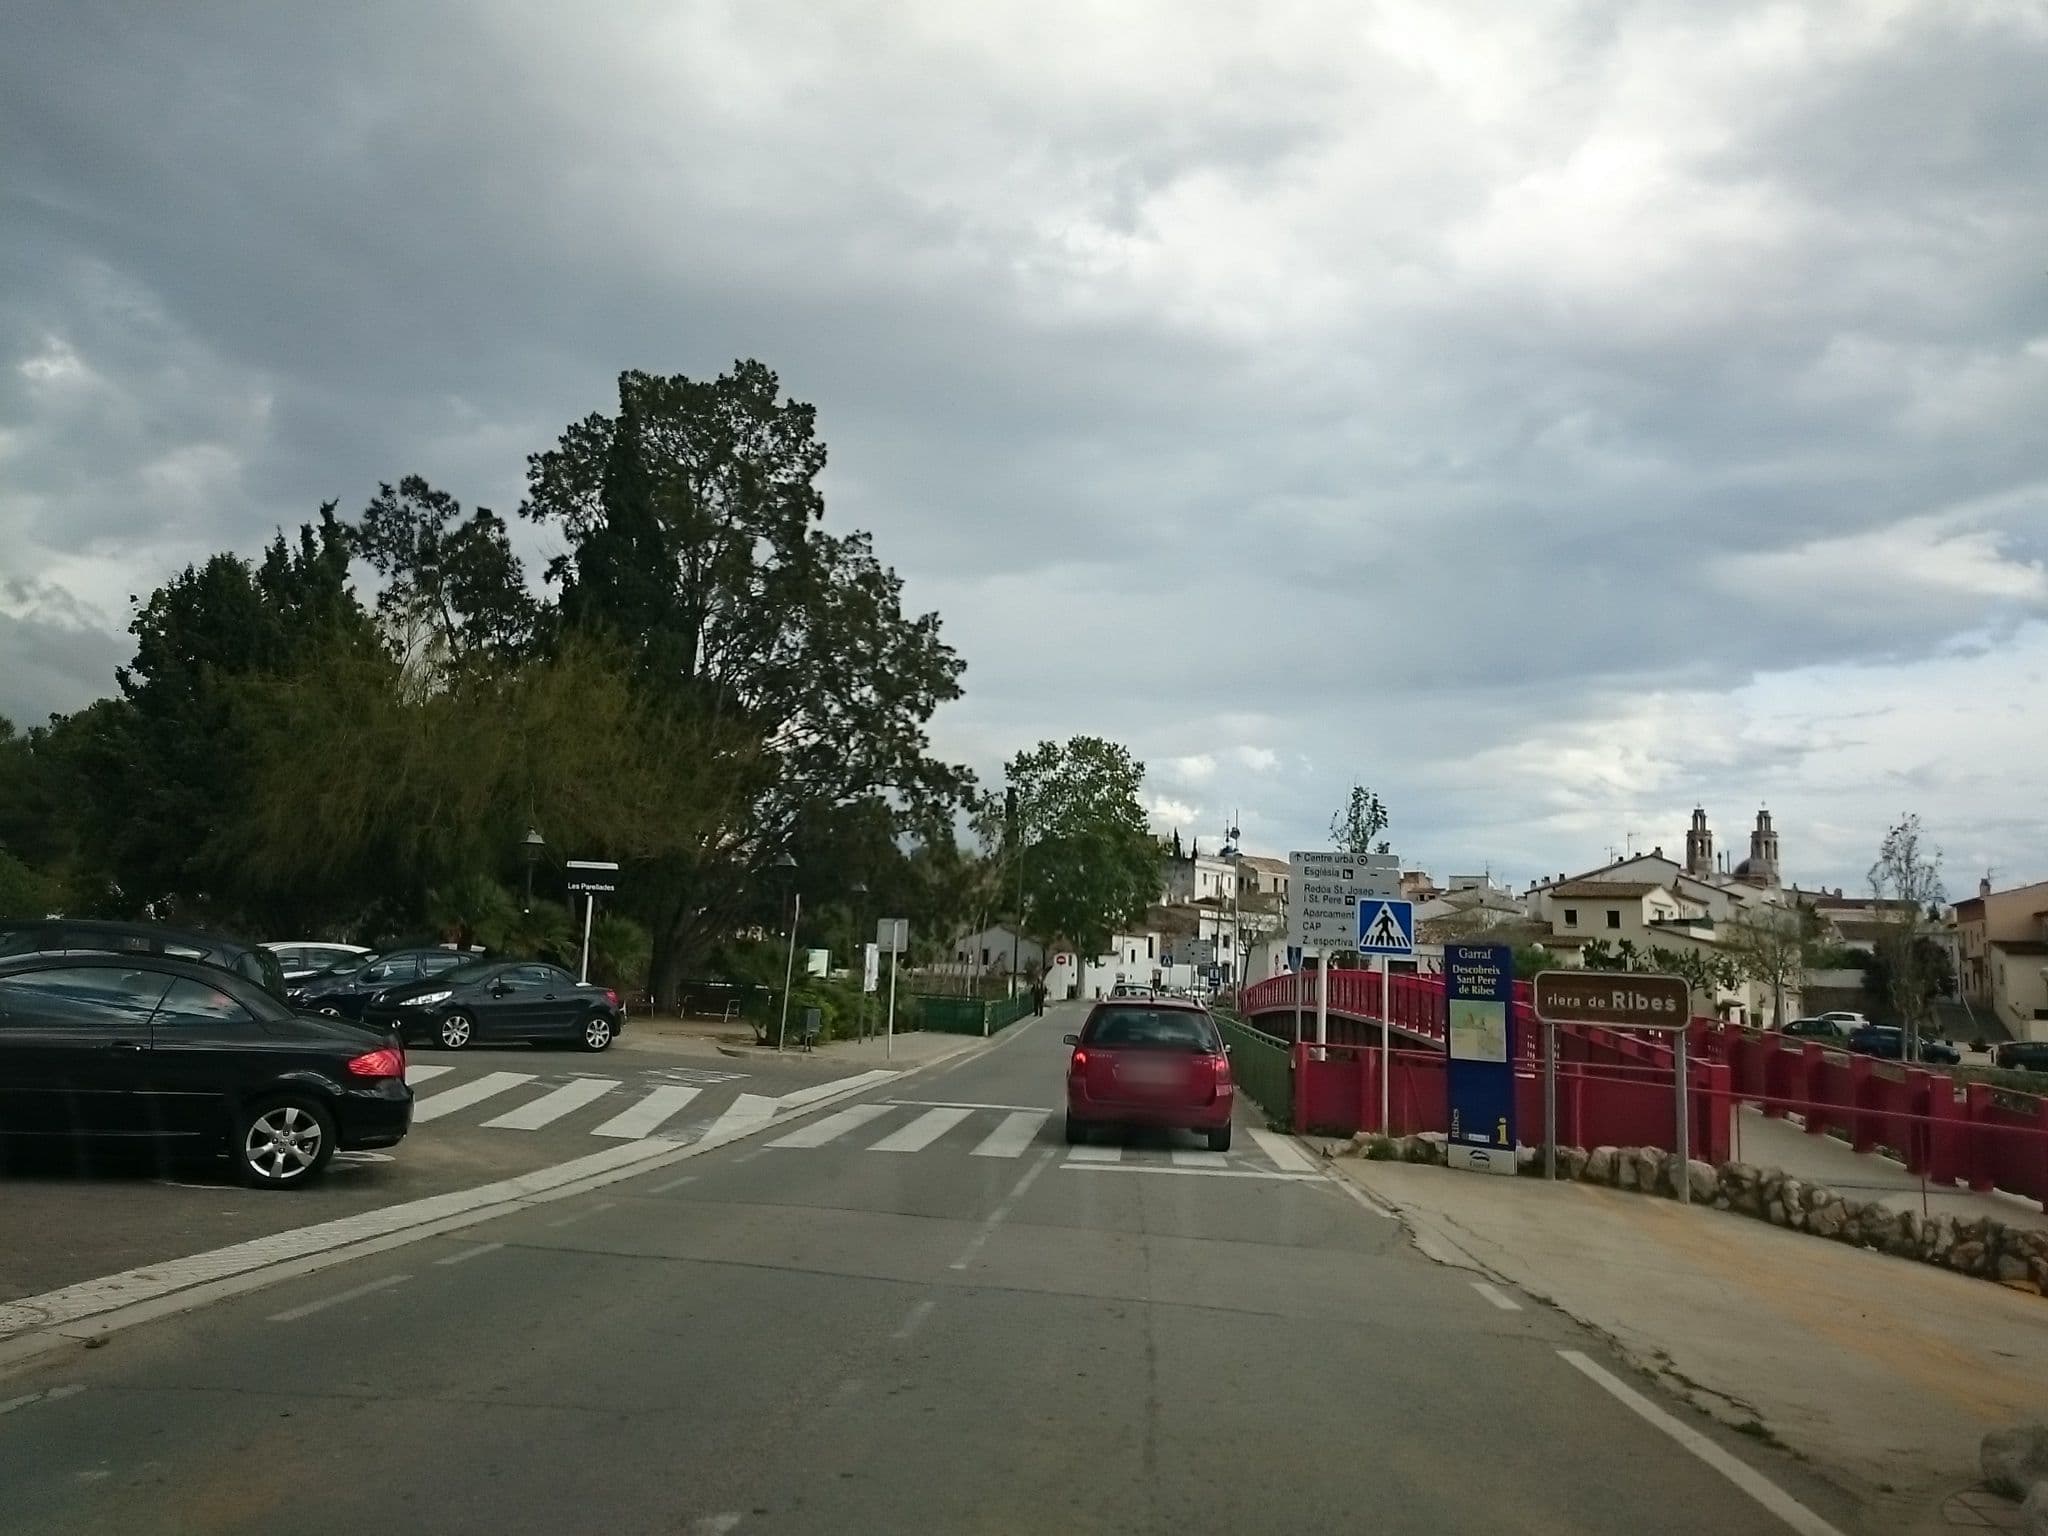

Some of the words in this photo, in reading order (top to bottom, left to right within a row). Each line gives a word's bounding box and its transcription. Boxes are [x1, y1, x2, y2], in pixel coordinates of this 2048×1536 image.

[1304, 852, 1332, 862] Centre
[1303, 908, 1355, 919] Aparcament
[1302, 921, 1321, 930] CAP
[1313, 937, 1353, 947] esportiva
[1459, 948, 1492, 959] Garraf
[1452, 964, 1501, 975] Descobreix
[1457, 974, 1475, 984] Sant
[1477, 975, 1497, 985] Pere
[1459, 985, 1470, 994] de
[1472, 985, 1495, 995] Ribes
[1548, 993, 1580, 1007] riera
[1588, 996, 1606, 1008] de
[1612, 991, 1676, 1012] Ribes
